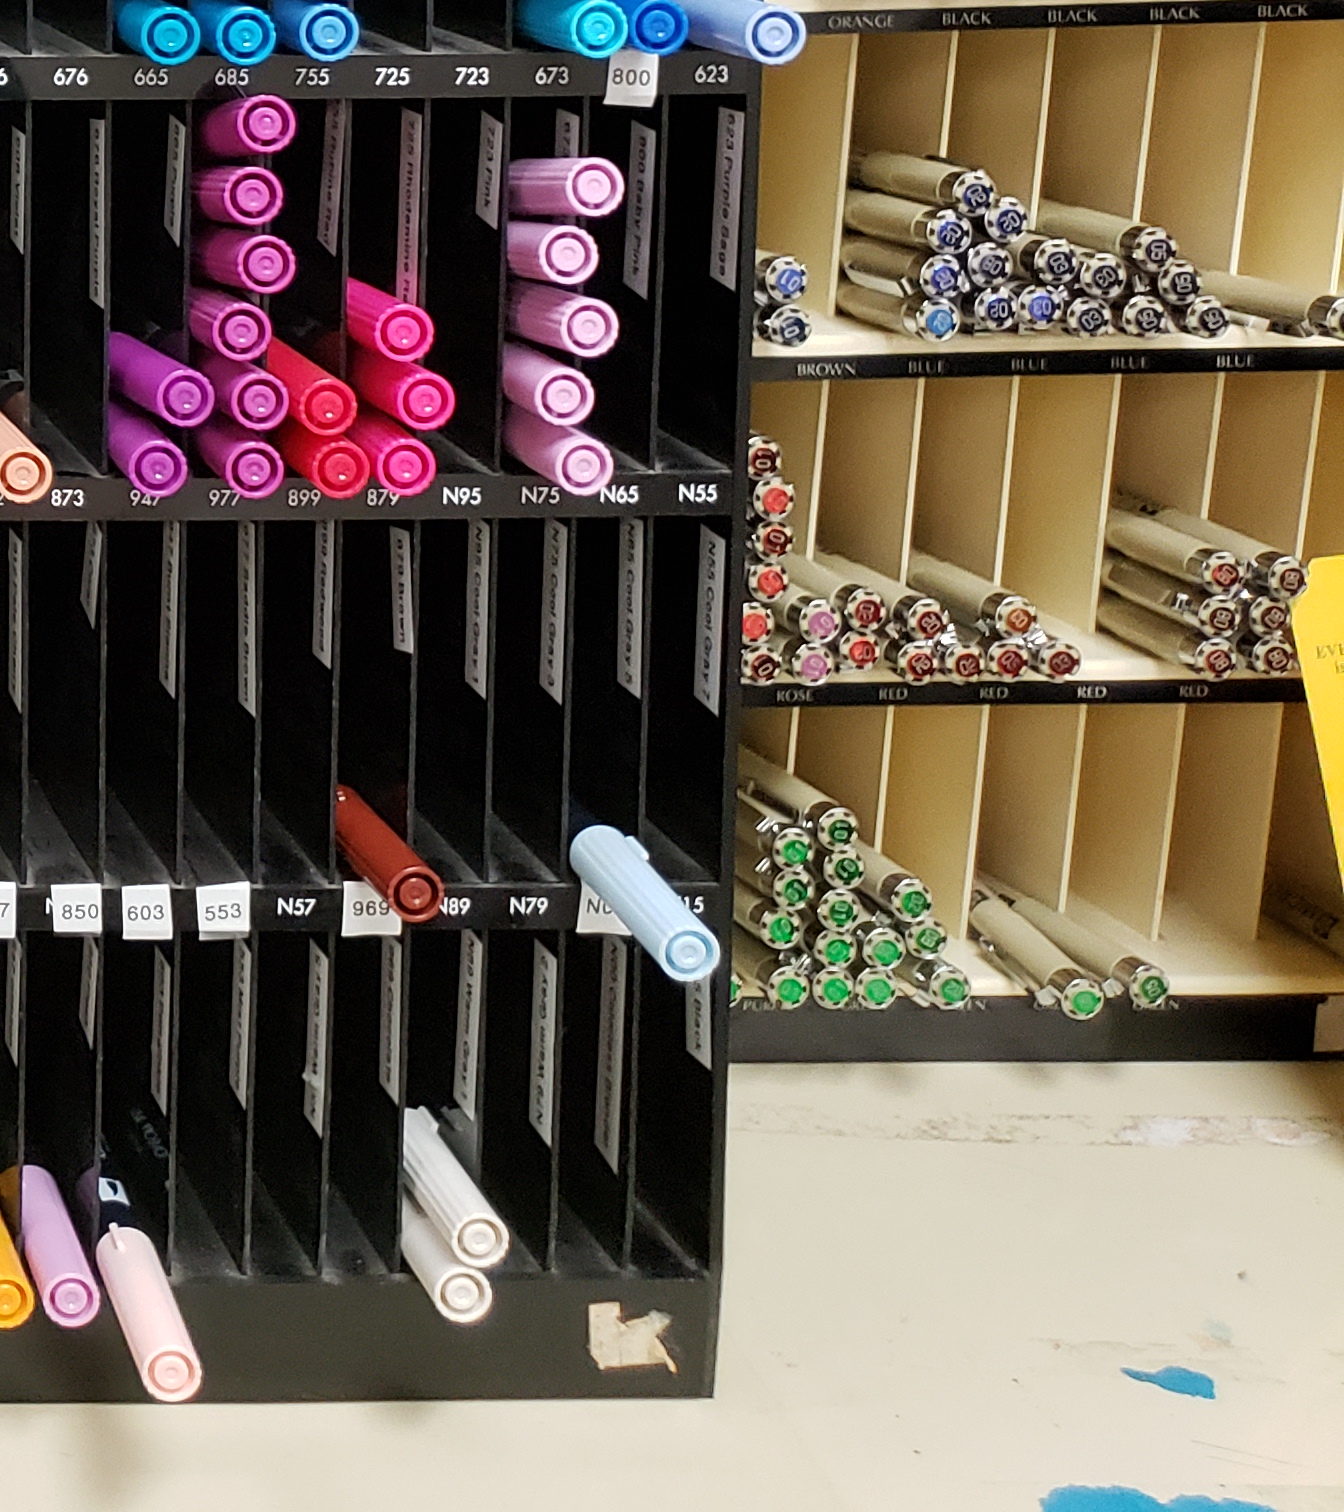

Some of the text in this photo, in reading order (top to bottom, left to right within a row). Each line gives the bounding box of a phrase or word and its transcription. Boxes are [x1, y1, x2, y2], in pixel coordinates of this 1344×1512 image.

[943, 11, 991, 26] BLACK
[1258, 3, 1308, 17] BLACK
[828, 14, 894, 30] ORANGE
[53, 67, 89, 85] 676
[374, 67, 411, 85] 725
[612, 69, 651, 85] 800
[694, 65, 729, 83] 623
[797, 361, 857, 376] BROWN
[1216, 354, 1254, 369] BLUE
[51, 489, 84, 507] 873
[442, 487, 482, 505] N95
[61, 903, 98, 920] 850
[127, 904, 165, 921] 603
[204, 903, 242, 921] 553
[277, 898, 316, 915] N57
[510, 897, 548, 914] N79
